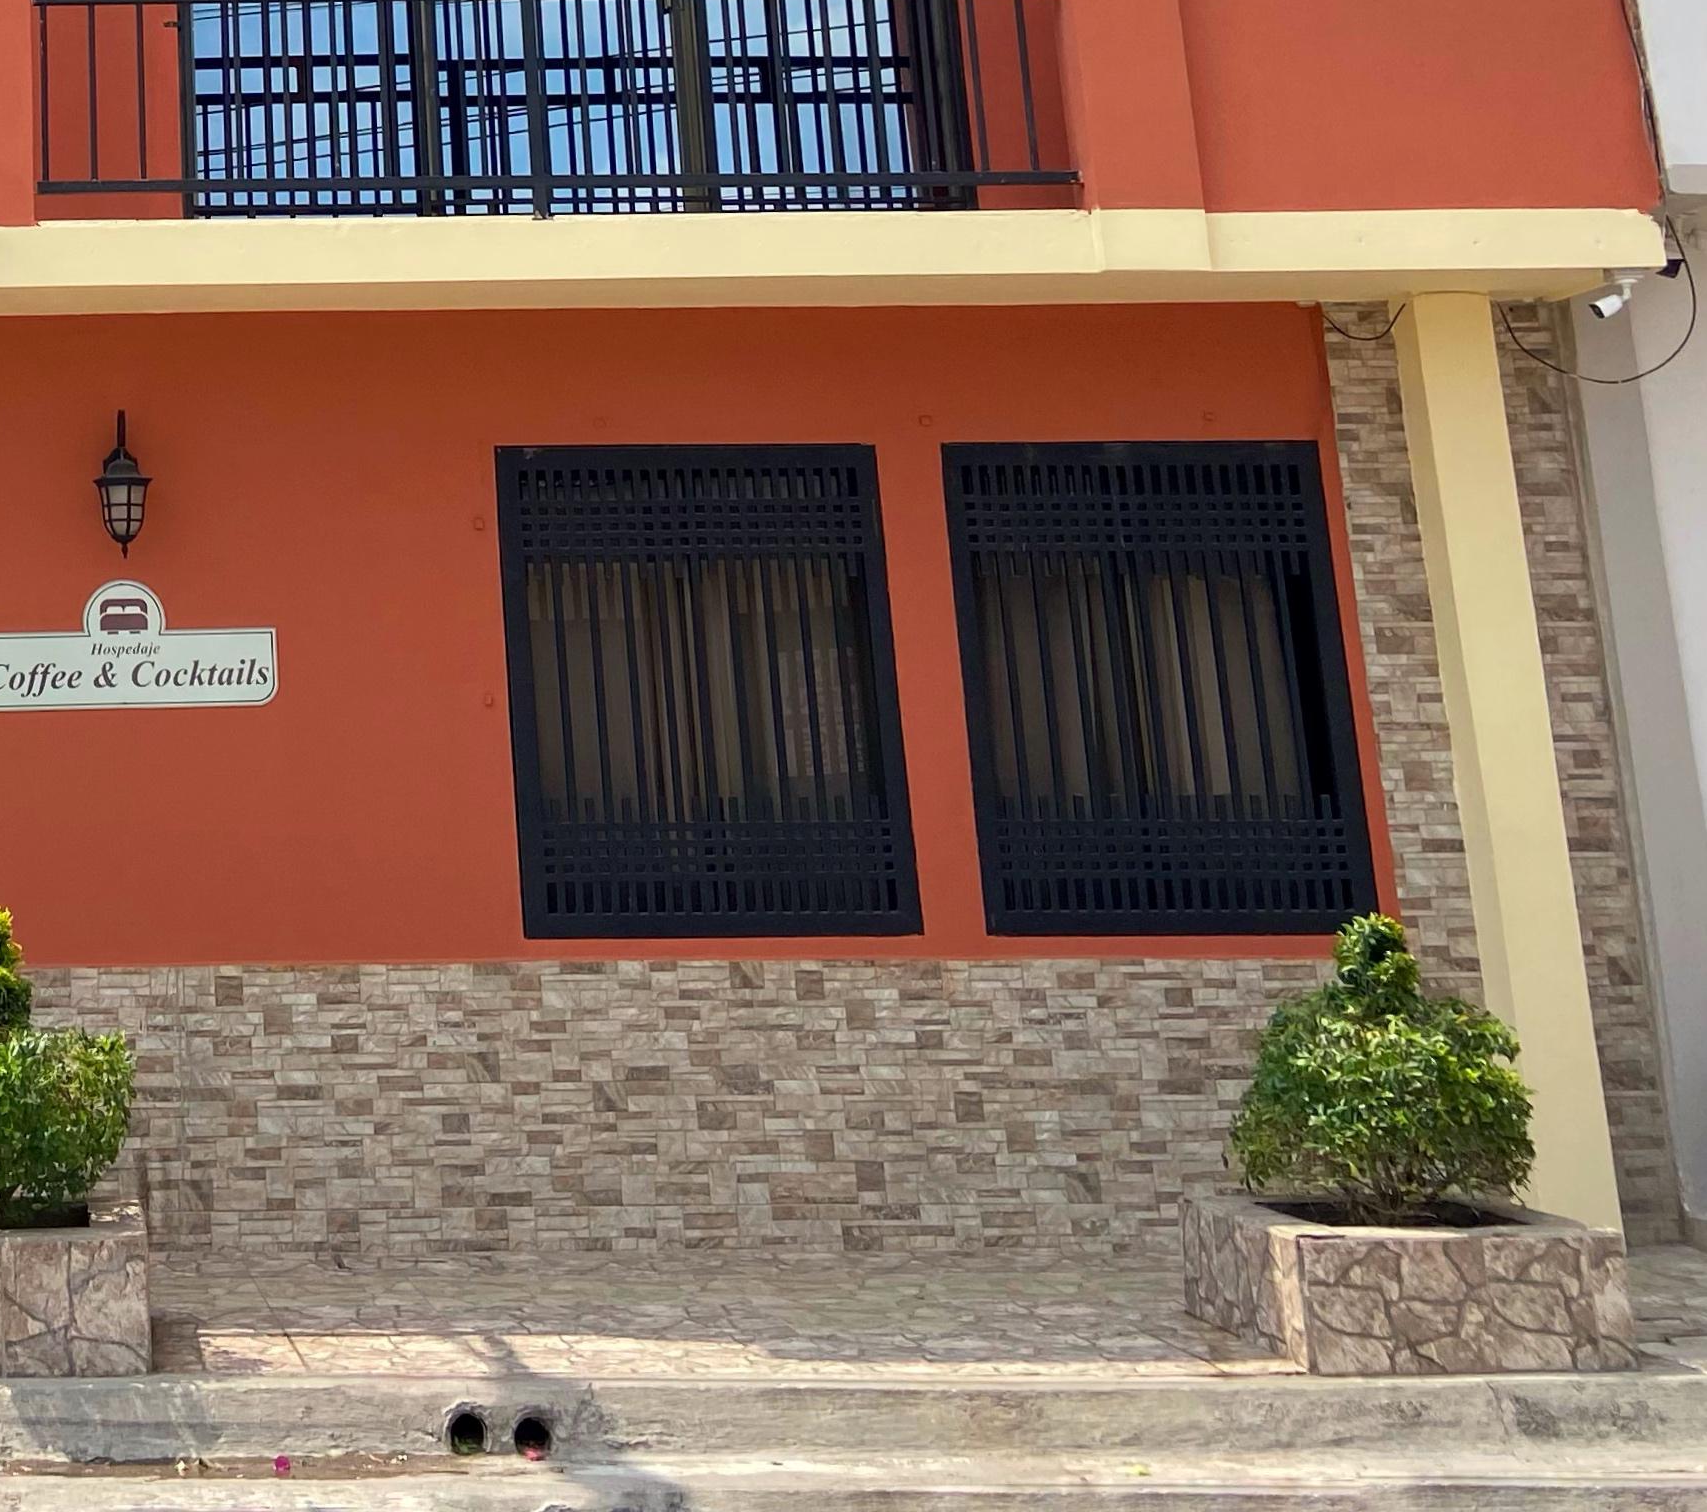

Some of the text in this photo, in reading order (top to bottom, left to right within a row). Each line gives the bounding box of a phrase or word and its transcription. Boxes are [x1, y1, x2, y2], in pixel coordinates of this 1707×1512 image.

[91, 642, 161, 657] Hospedaje
[93, 661, 118, 688] &
[131, 659, 270, 687] Cocktails
